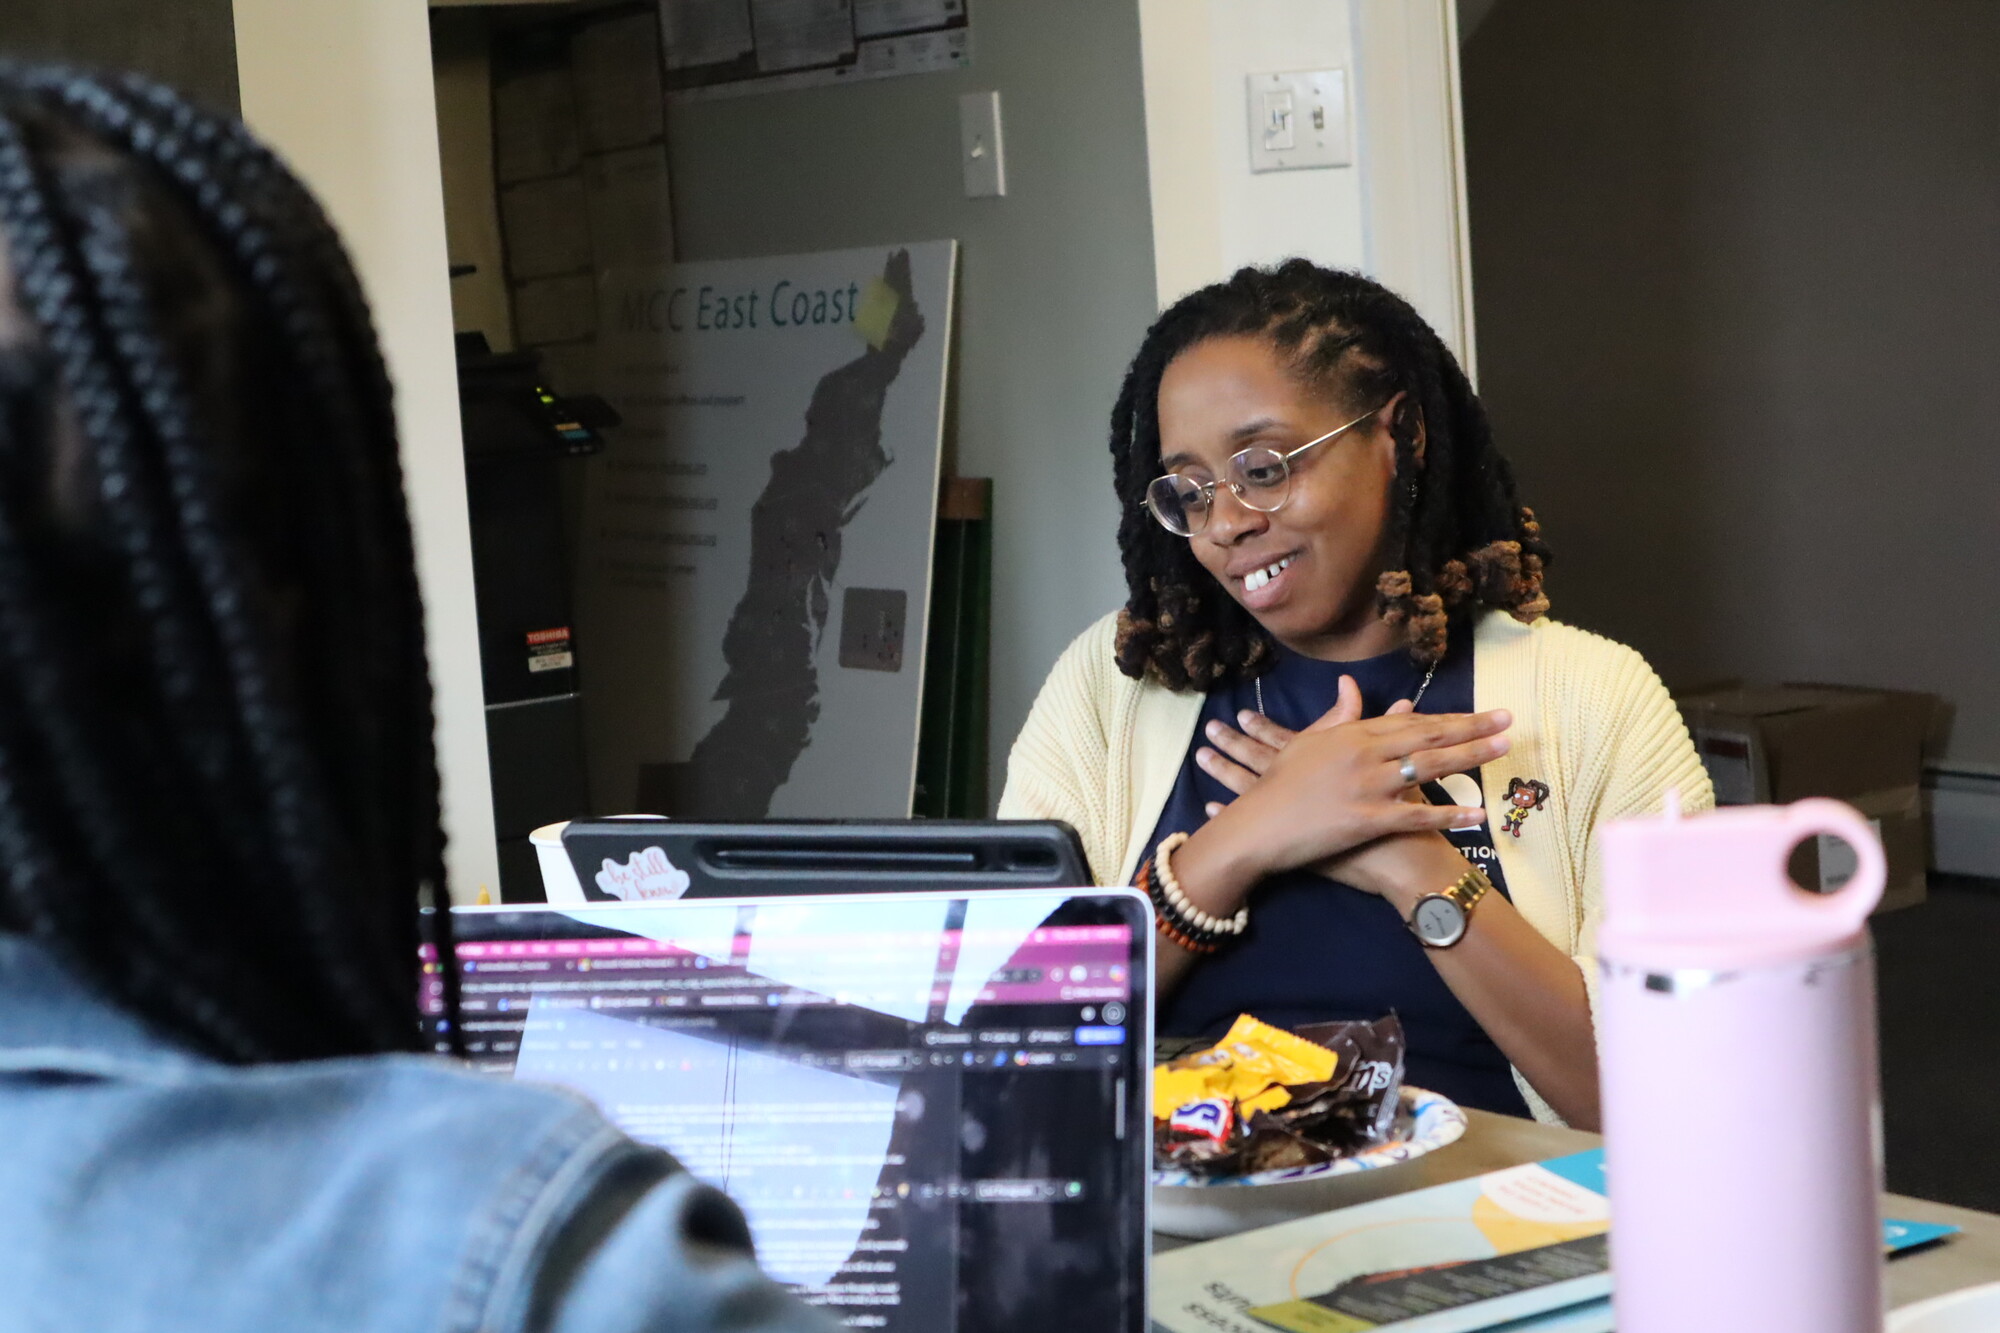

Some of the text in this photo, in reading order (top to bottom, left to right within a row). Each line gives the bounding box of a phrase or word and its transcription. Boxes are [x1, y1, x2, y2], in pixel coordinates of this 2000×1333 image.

[697, 286, 758, 330] East
[770, 279, 858, 327] Coast
[527, 628, 569, 643] TOSHIBA
[1455, 845, 1496, 860] TION
